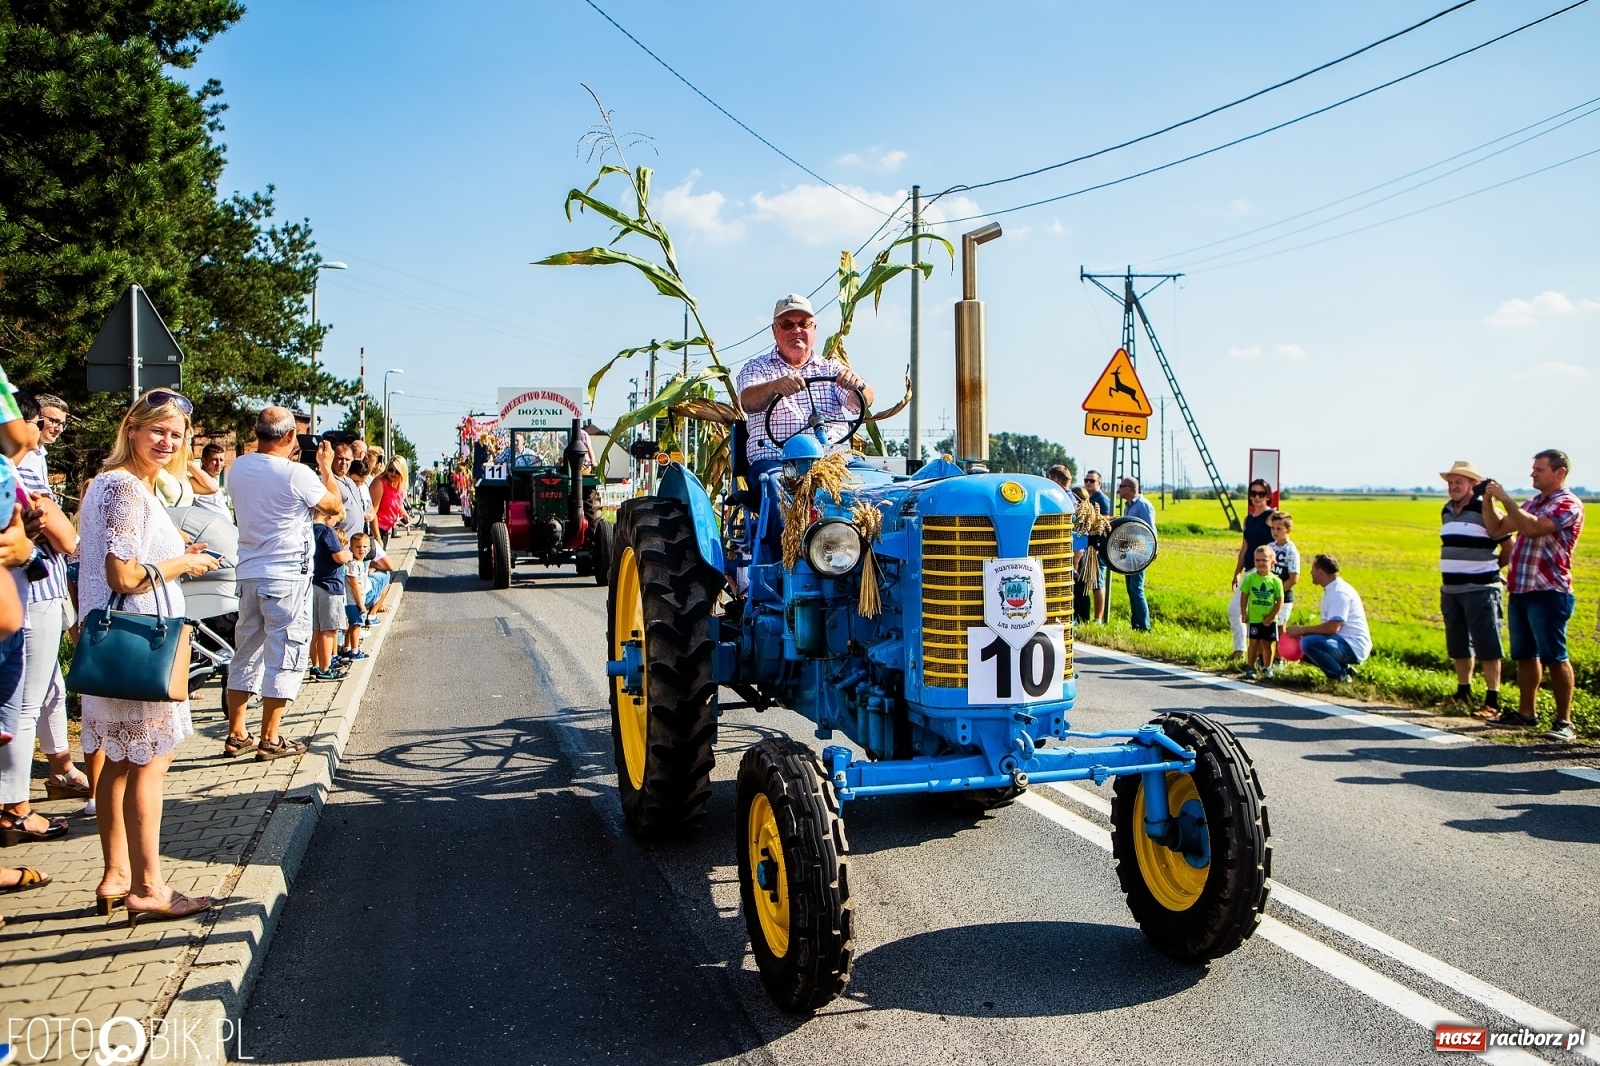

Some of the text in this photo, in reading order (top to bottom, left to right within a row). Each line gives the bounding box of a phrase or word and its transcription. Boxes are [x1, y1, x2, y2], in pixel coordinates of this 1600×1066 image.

[518, 407, 563, 416] DOŻYNKI
[1092, 418, 1141, 434] Koniec
[489, 466, 502, 478] 11
[540, 491, 563, 499] URSUS
[981, 632, 1055, 698] 10
